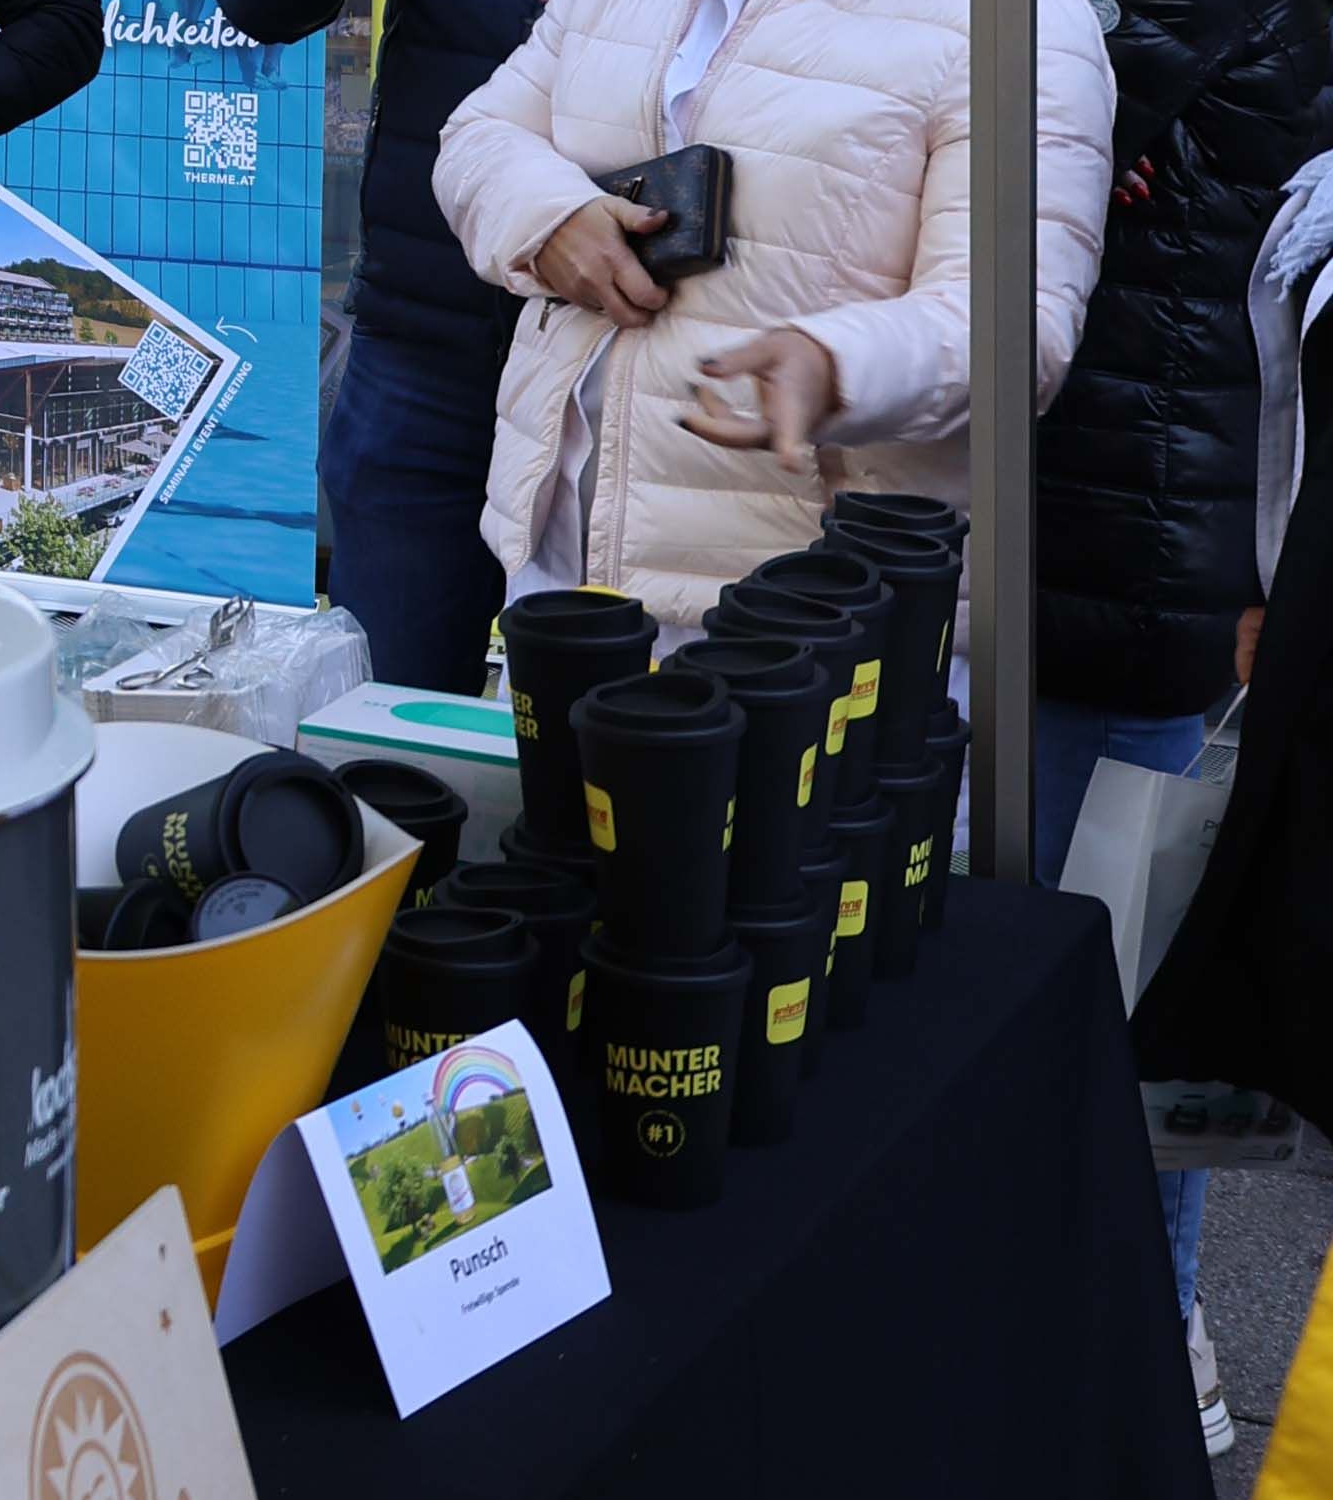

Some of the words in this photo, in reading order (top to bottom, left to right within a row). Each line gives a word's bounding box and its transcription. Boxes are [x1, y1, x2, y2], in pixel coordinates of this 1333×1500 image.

[183, 171, 256, 187] THERME.AT
[159, 454, 194, 505] SEMINAR
[192, 413, 219, 453] EVENT
[217, 360, 253, 412] MEETING
[386, 1022, 480, 1055] UNTE
[606, 1042, 721, 1073] MUNTER
[605, 1068, 722, 1098] MACHER
[646, 1123, 675, 1144] #1
[449, 1235, 509, 1284] Punsch
